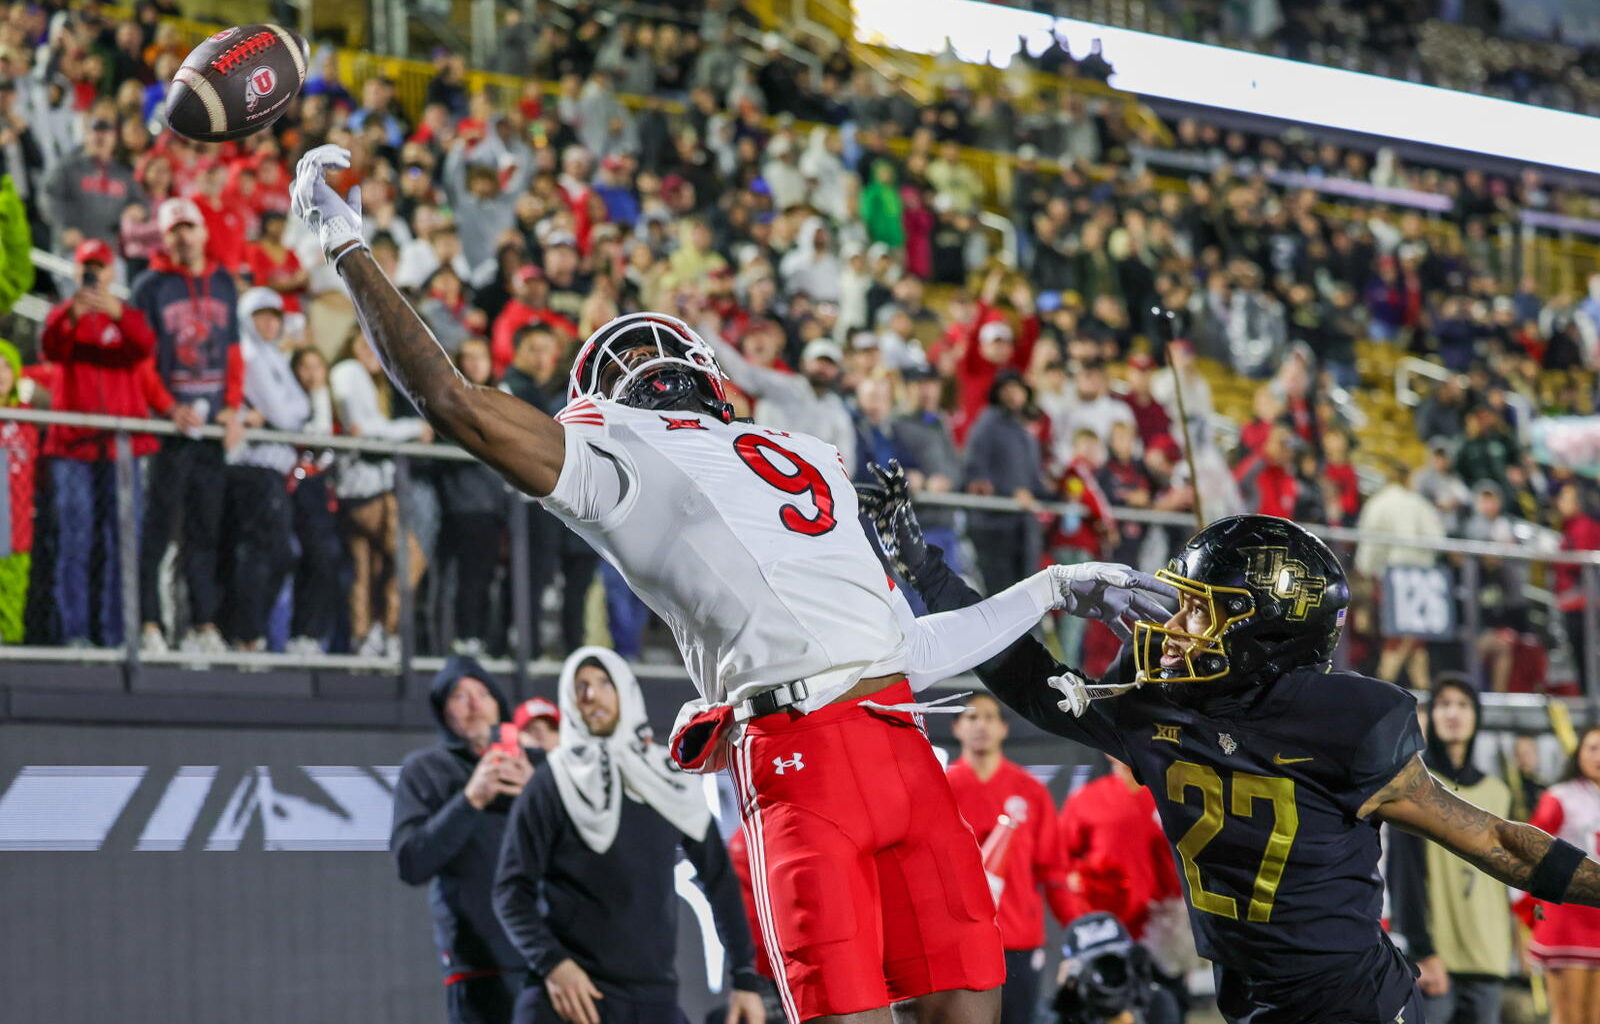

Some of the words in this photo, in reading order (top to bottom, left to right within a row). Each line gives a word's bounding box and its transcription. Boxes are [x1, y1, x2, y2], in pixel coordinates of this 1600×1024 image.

[252, 70, 273, 93] U
[733, 433, 838, 537] 9
[1236, 545, 1327, 621] UCF
[1152, 723, 1182, 745] XII
[1166, 760, 1299, 923] 27
